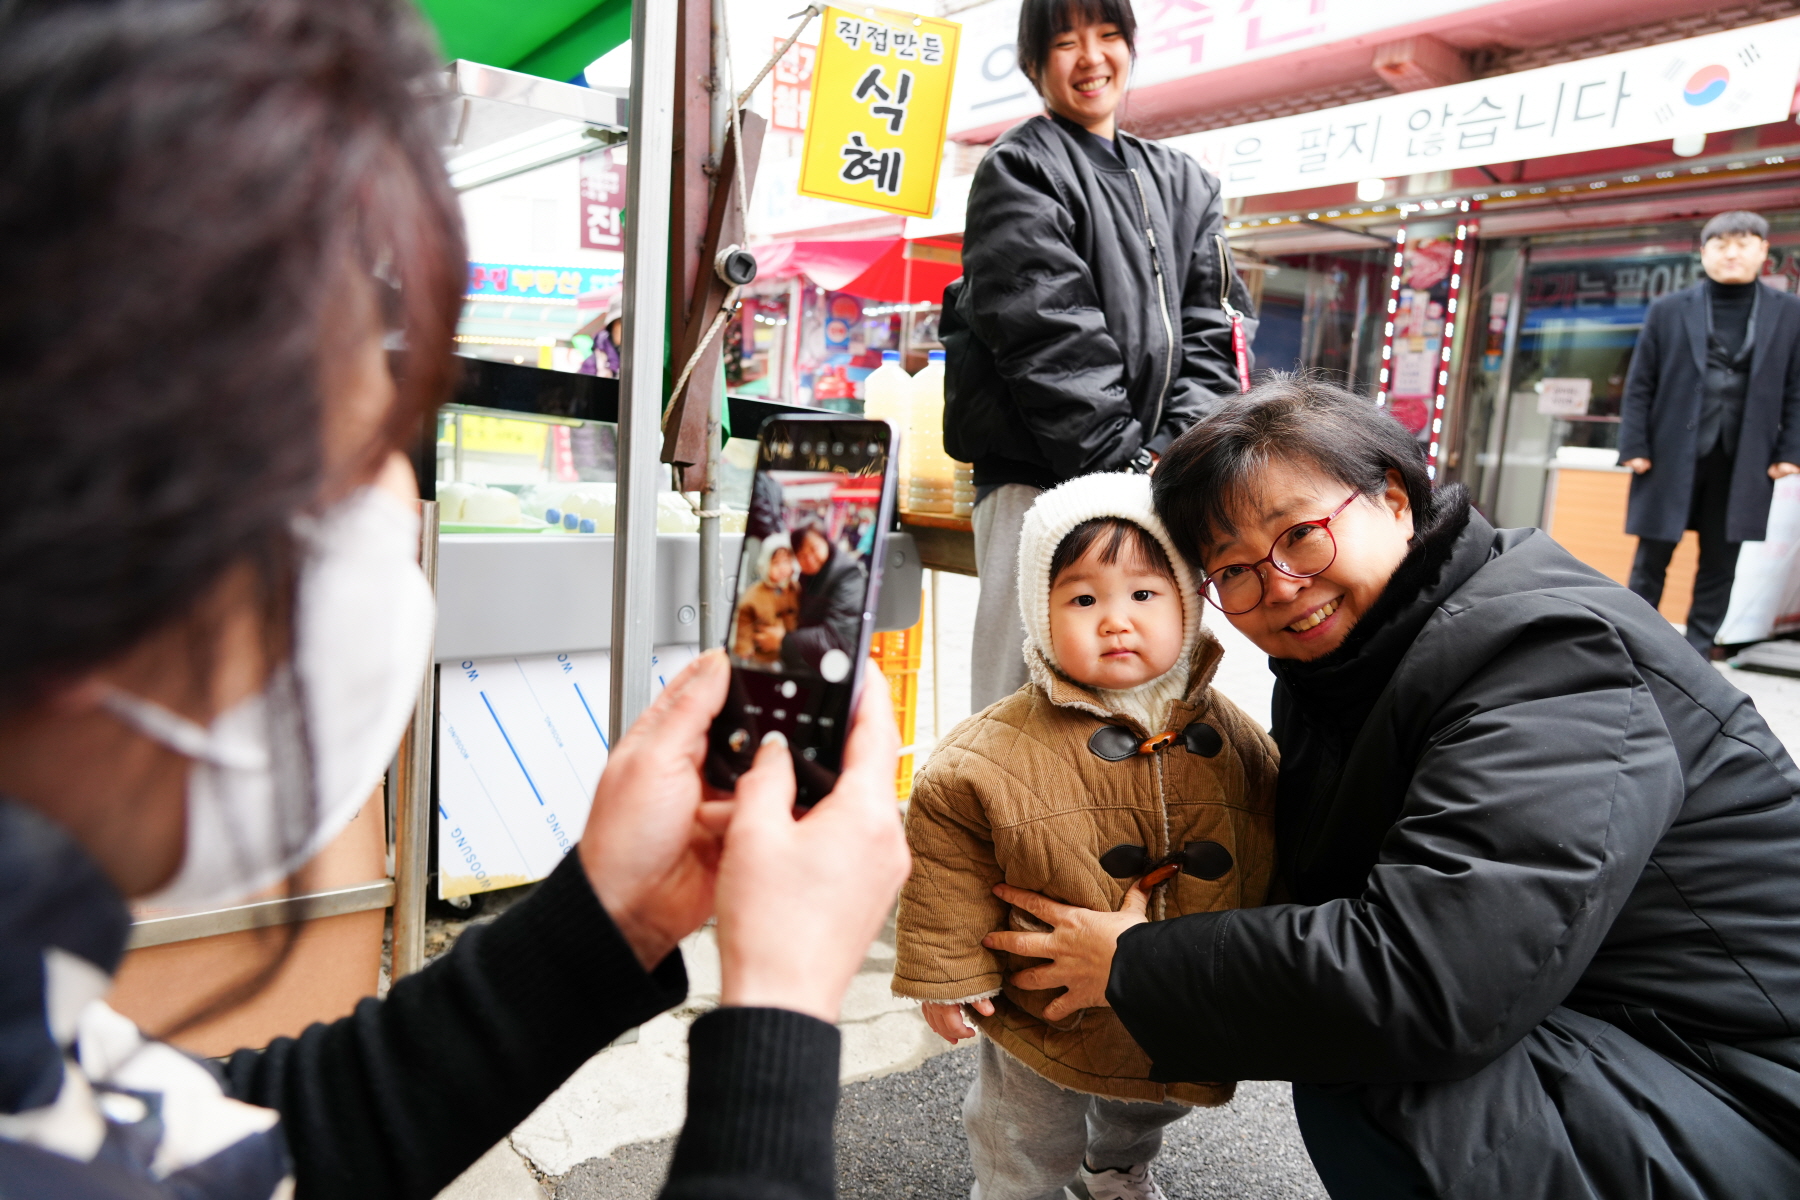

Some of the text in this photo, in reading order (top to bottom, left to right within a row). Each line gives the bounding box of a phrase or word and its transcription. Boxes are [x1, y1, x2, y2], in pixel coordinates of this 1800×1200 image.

[839, 21, 940, 62] 직접만든
[843, 69, 911, 192] 식혜
[1297, 115, 1382, 174] 팔지
[1406, 71, 1632, 157] 않습니다
[450, 828, 492, 891] WOOSUNG
